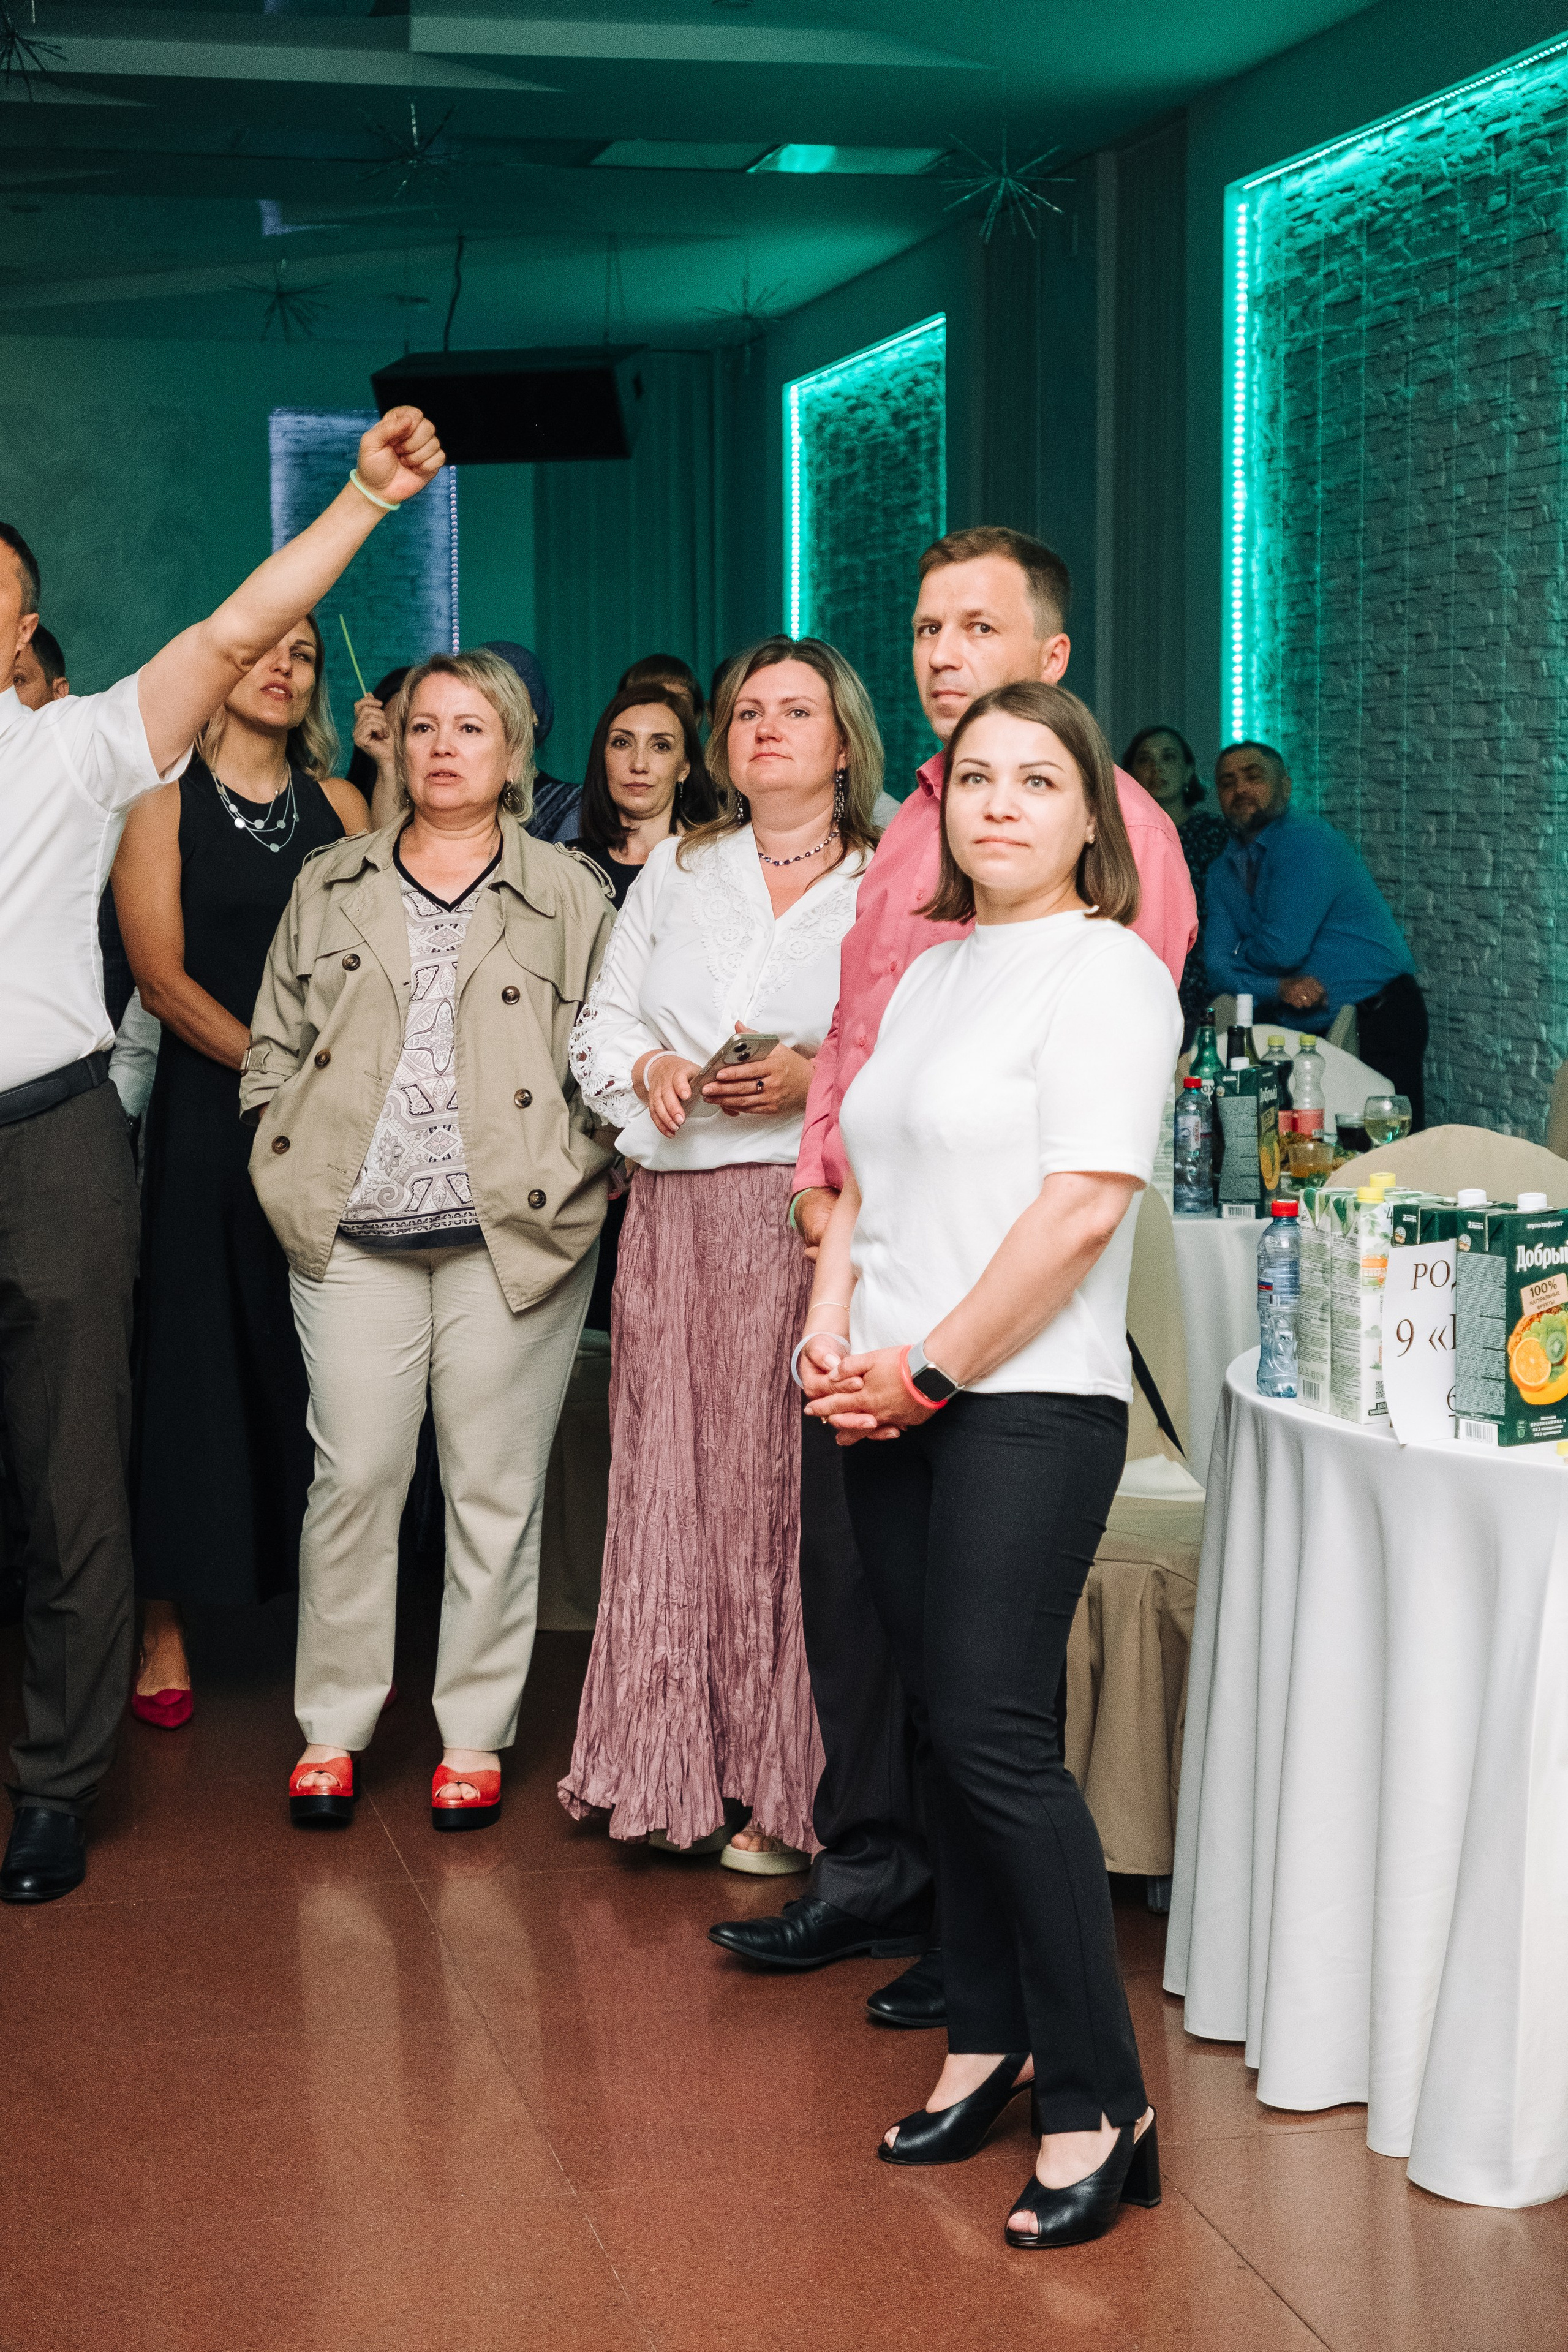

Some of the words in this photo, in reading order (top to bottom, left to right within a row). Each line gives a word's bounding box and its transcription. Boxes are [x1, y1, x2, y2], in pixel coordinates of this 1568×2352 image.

[1411, 1260, 1456, 1293] РО
[1530, 1278, 1557, 1297] 100%
[1530, 1291, 1560, 1305] НАТУРАЛЬНЫЕ
[1537, 1300, 1555, 1310] ФРУКТЫ
[1396, 1319, 1414, 1357] 9
